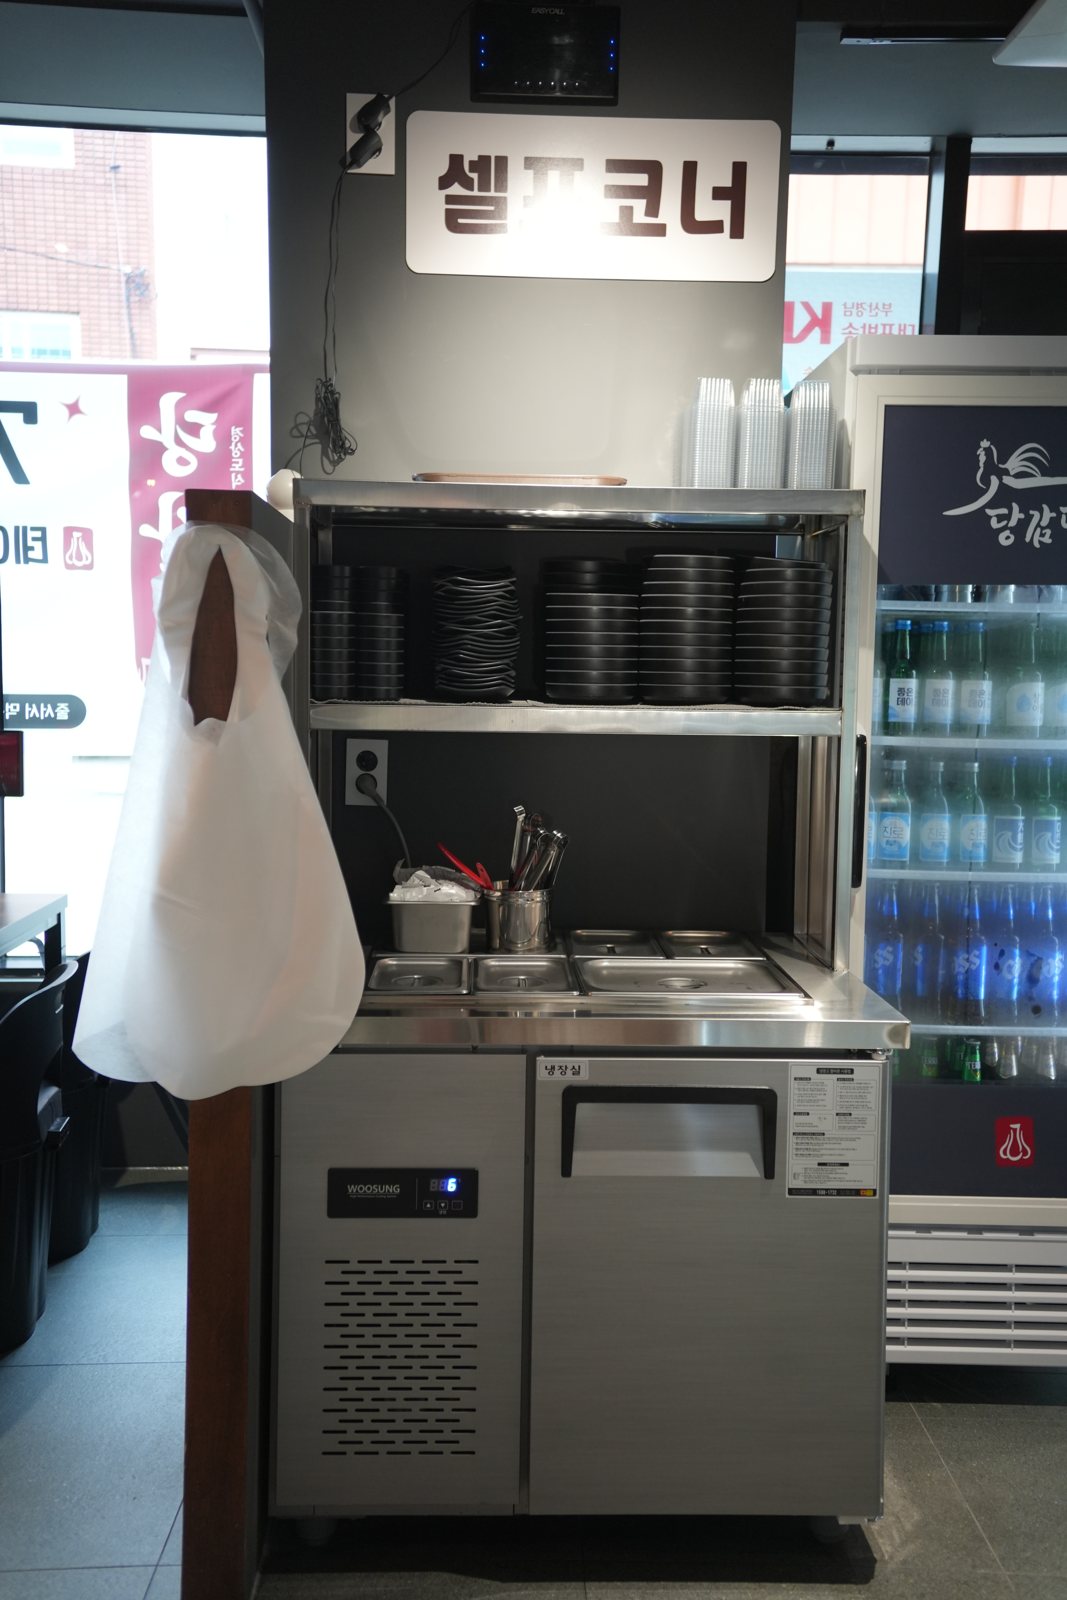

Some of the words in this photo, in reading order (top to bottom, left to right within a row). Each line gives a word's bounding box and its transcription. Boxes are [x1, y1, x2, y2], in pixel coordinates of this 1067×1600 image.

[531, 7, 566, 15] EASYCALL
[545, 1064, 581, 1076] 냉장실
[347, 1184, 400, 1193] WOOSUNG
[447, 1177, 457, 1192] 6
